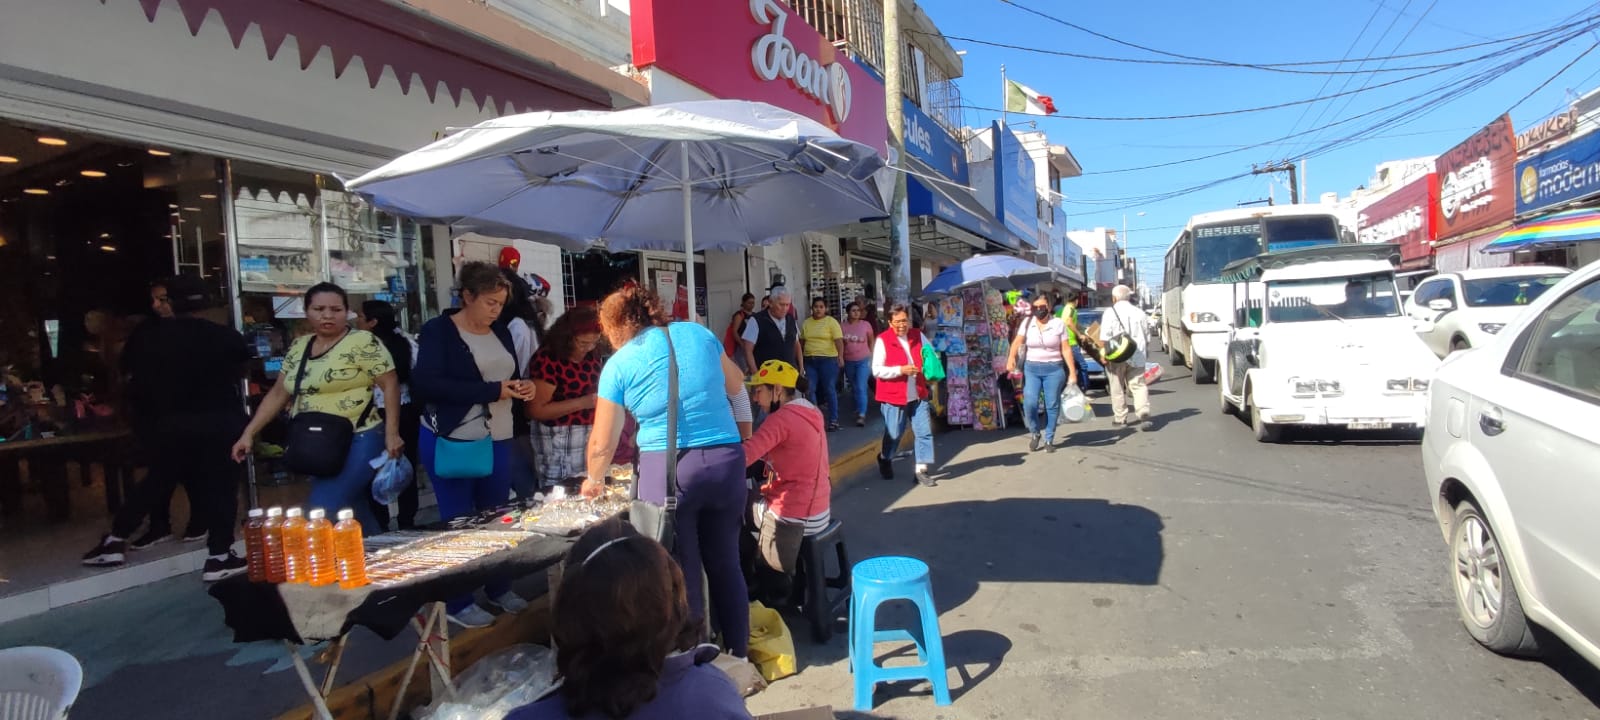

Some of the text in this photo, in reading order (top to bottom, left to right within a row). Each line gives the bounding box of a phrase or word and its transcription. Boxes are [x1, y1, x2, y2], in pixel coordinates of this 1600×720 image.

[749, 0, 831, 104] Joan
[1538, 160, 1569, 177] farmacias
[1539, 162, 1600, 199] modern
